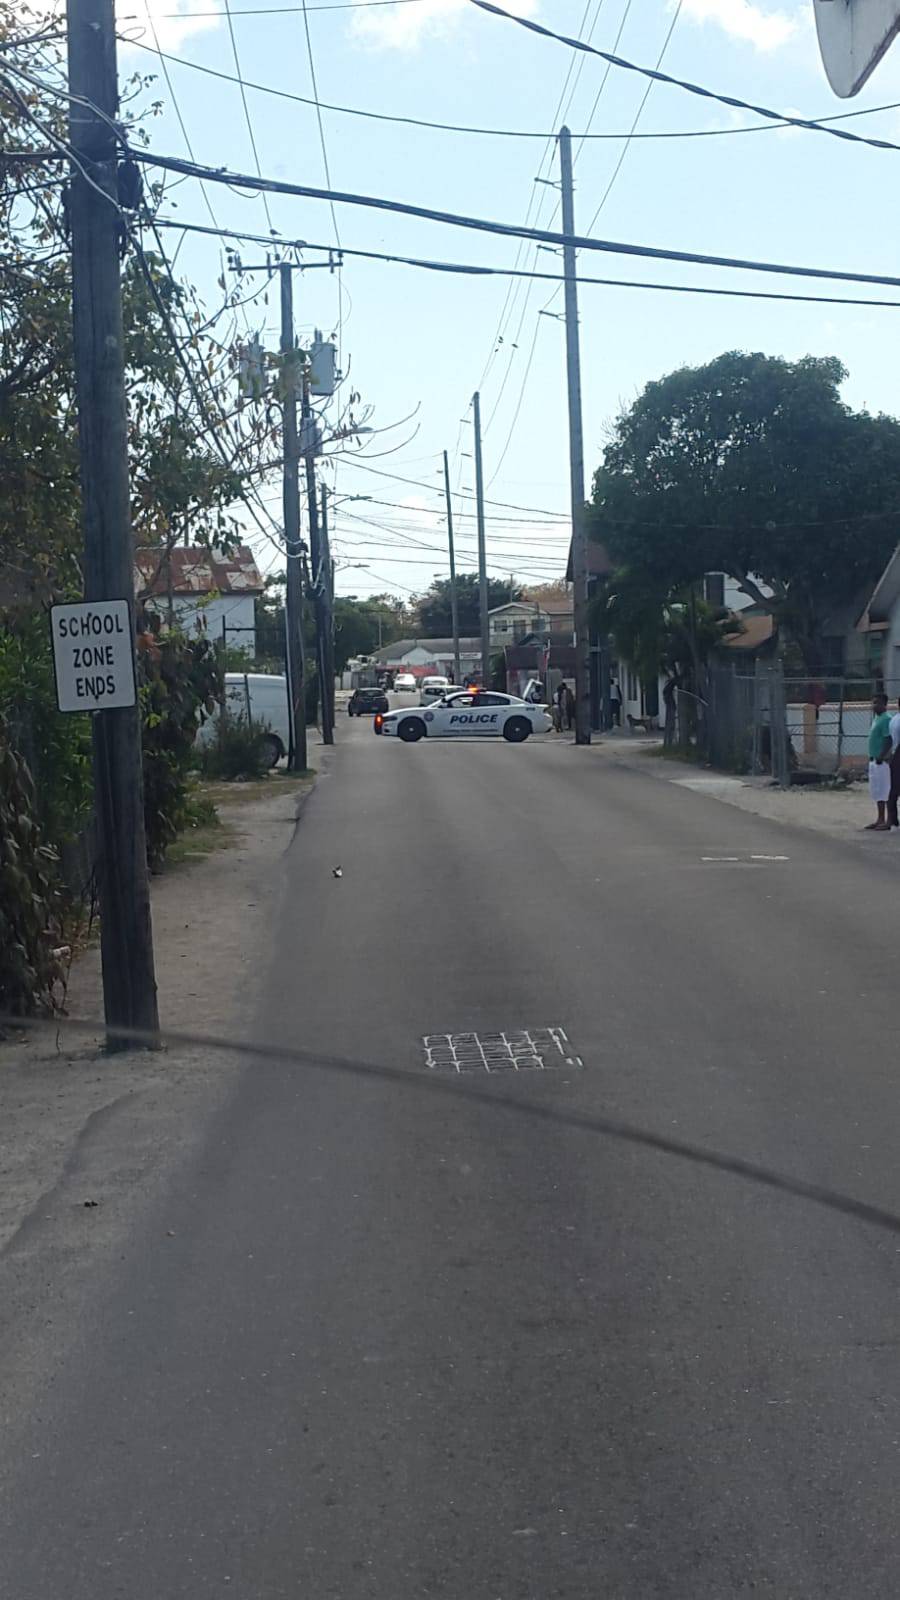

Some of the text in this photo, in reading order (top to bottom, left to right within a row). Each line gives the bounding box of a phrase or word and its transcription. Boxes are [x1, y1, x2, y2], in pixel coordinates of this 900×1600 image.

[59, 614, 123, 638] SCHOOL
[73, 645, 114, 668] ZONE
[76, 675, 116, 697] ENDS
[450, 714, 498, 724] POLICE
